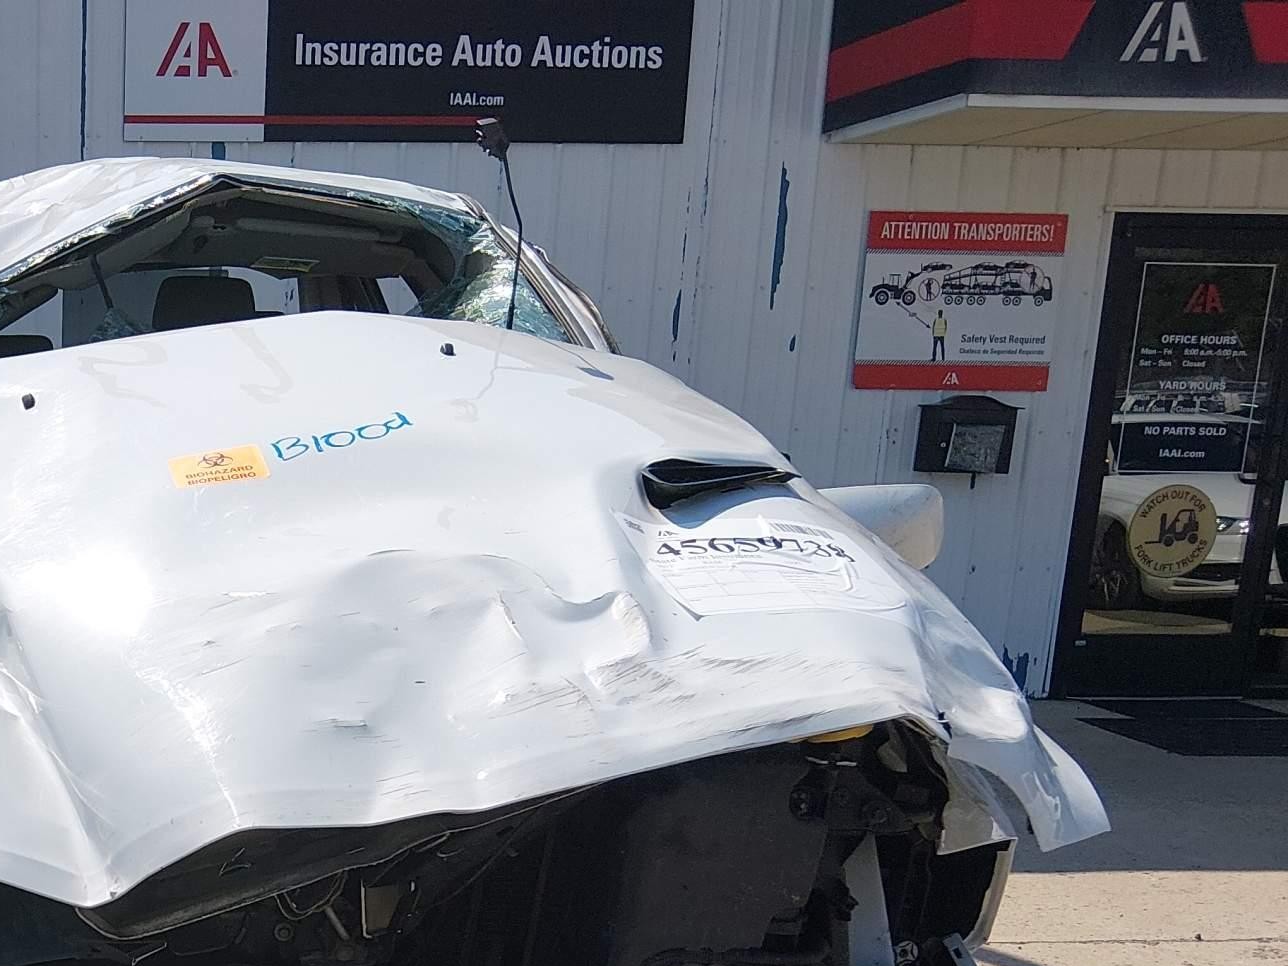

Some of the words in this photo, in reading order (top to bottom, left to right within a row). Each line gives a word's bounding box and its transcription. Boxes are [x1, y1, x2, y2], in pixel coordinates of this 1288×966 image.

[295, 33, 443, 67] Insurance
[451, 34, 522, 68] Auto
[530, 35, 663, 69] Auctions
[449, 92, 504, 106] IAAI.com
[881, 221, 949, 240] ATTENTION
[954, 222, 1054, 242] TRANSPORTERS!
[961, 334, 987, 345] Safety
[989, 335, 1007, 344] Vest
[1008, 335, 1045, 346] Required
[1162, 335, 1198, 344] OFFICE
[1200, 335, 1237, 345] HOURS
[1159, 381, 1187, 390] YARD
[1189, 381, 1226, 390] HOURS
[1144, 426, 1160, 435] NO
[1162, 427, 1196, 436] PARTS
[1199, 427, 1227, 436] SOLD
[1159, 449, 1205, 458] IAAI.com
[185, 465, 253, 479] BIOHAZARD
[187, 472, 256, 485] BIOPELIGRO
[1139, 491, 1168, 518] WATCH
[1171, 490, 1191, 500] OUT
[1189, 494, 1206, 512] FOR
[1134, 545, 1153, 567] FORK
[1153, 562, 1174, 572] LIFT
[1176, 539, 1207, 570] TRUCKS
